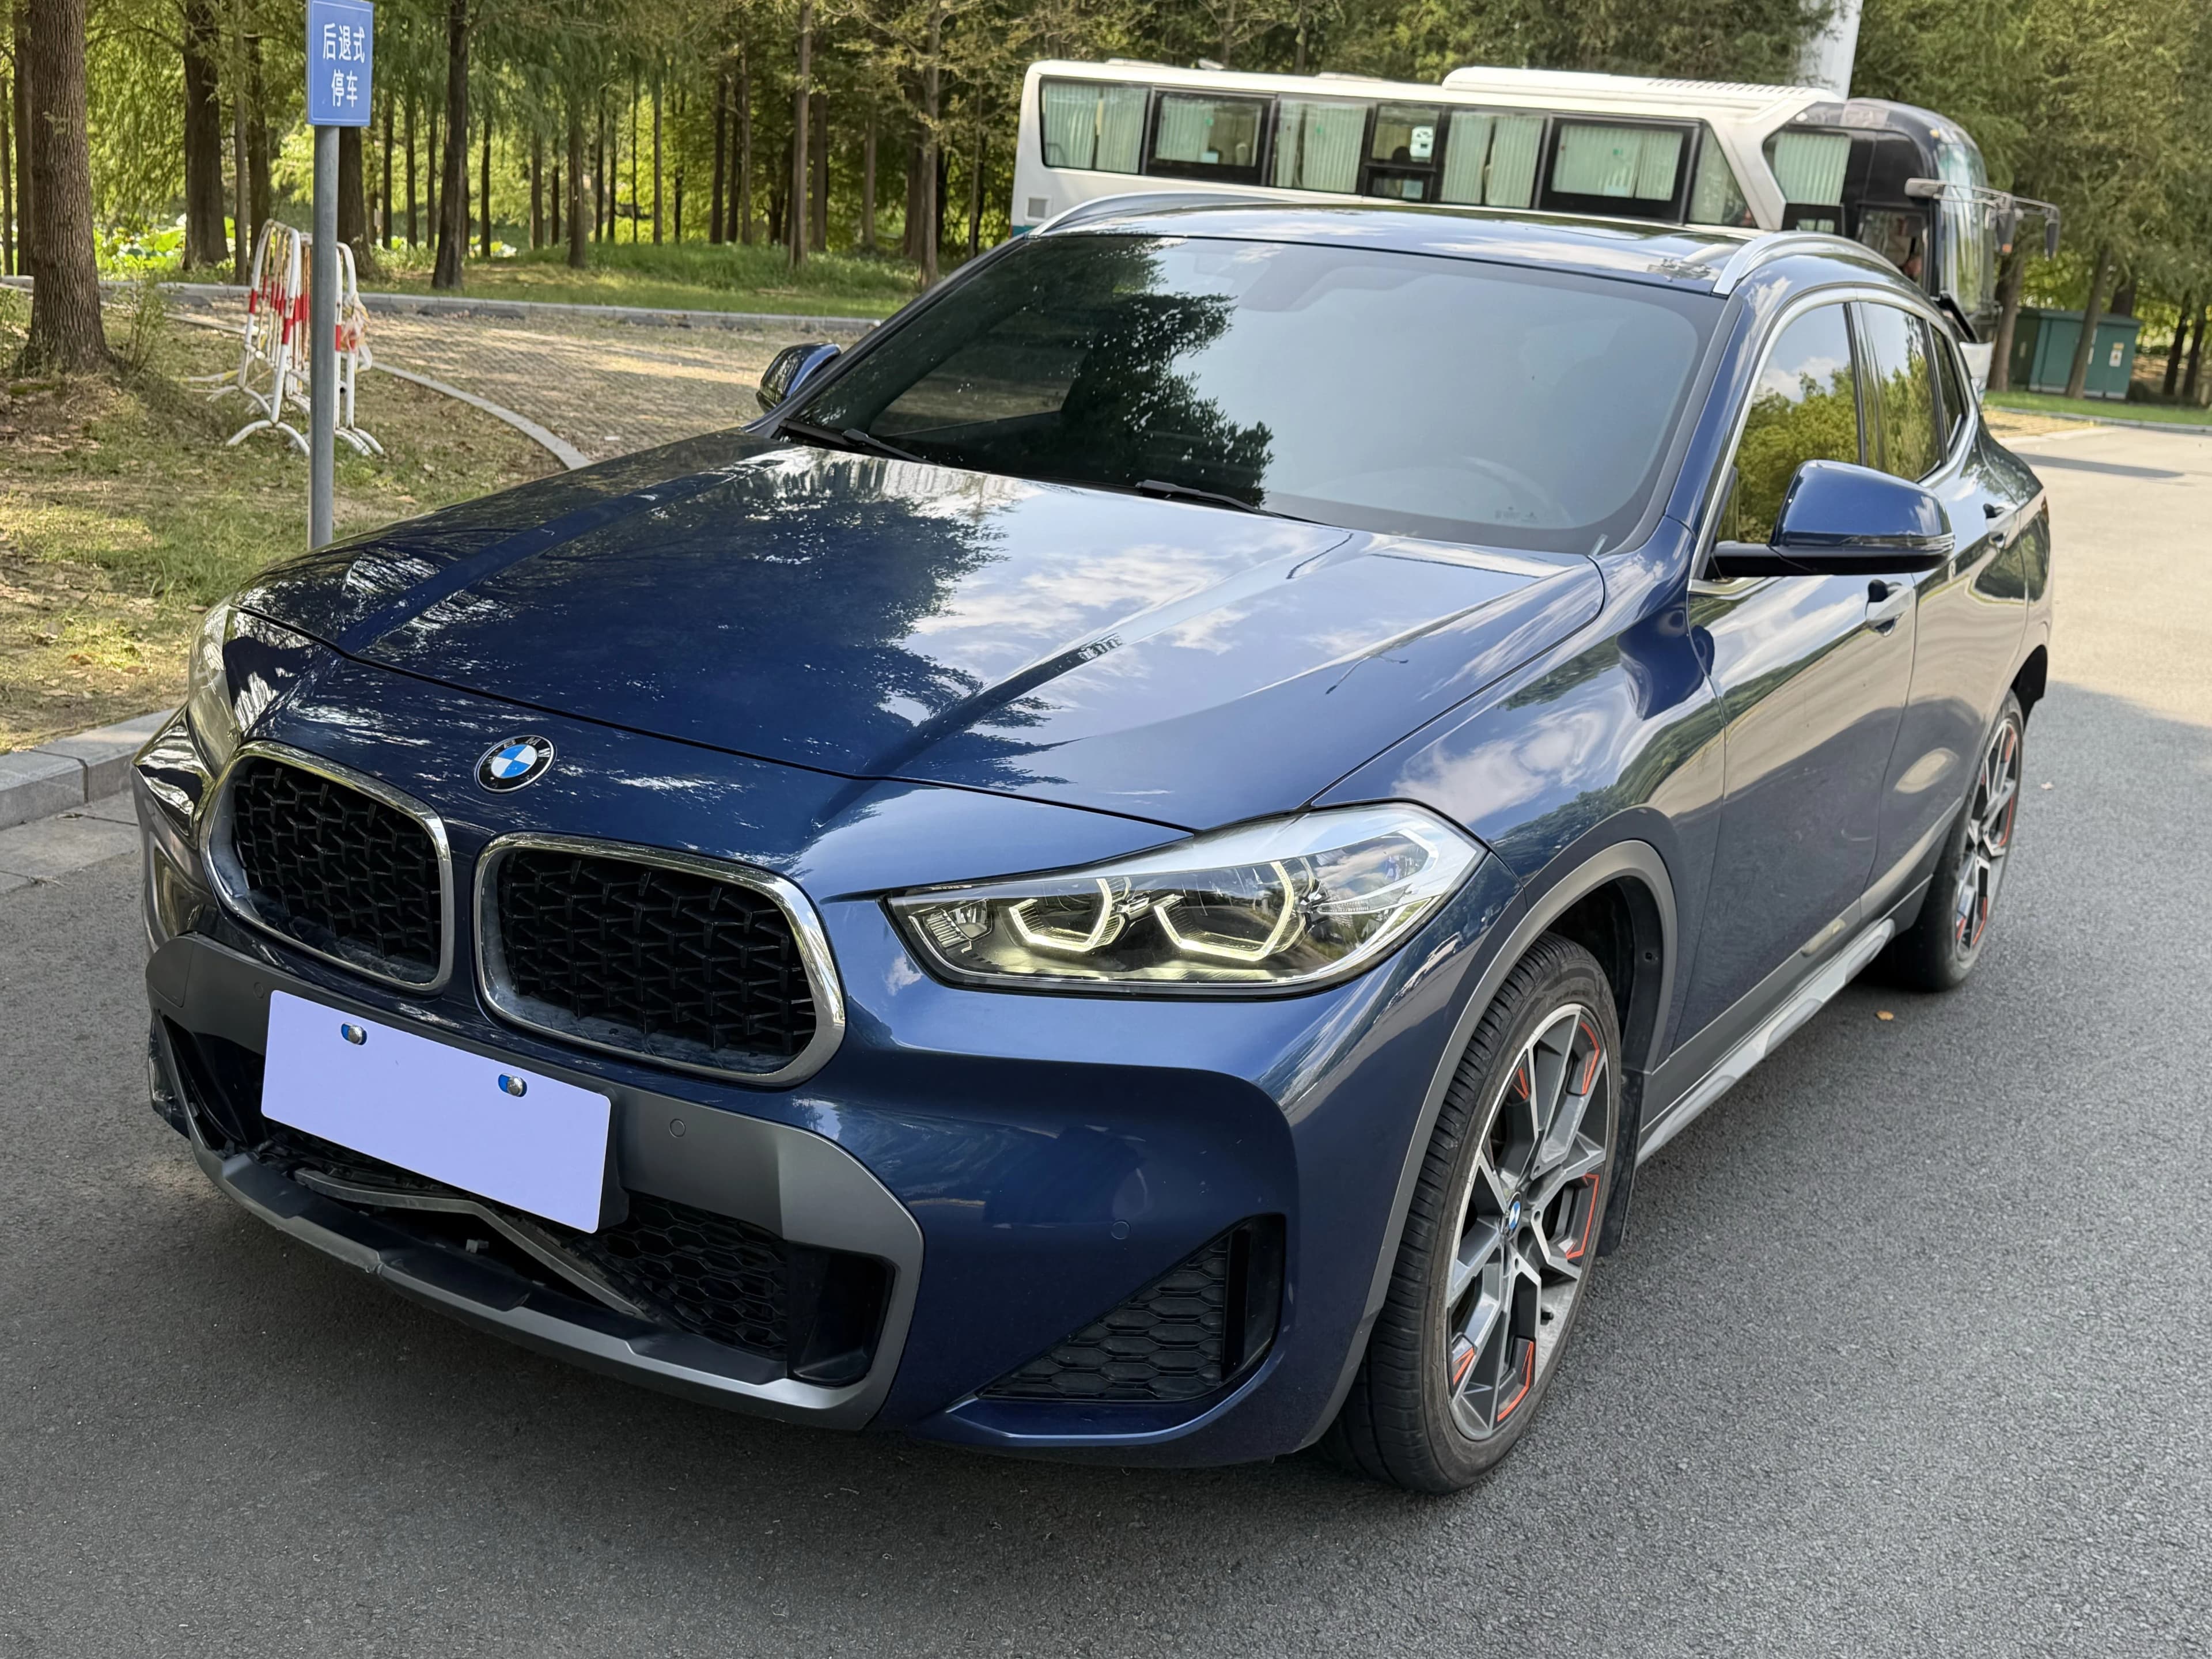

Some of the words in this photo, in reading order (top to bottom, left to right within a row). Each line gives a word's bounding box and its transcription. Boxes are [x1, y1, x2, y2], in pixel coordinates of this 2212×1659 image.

[323, 22, 365, 63] 后退式
[331, 69, 358, 108] 停车
[503, 737, 551, 757] BMW
